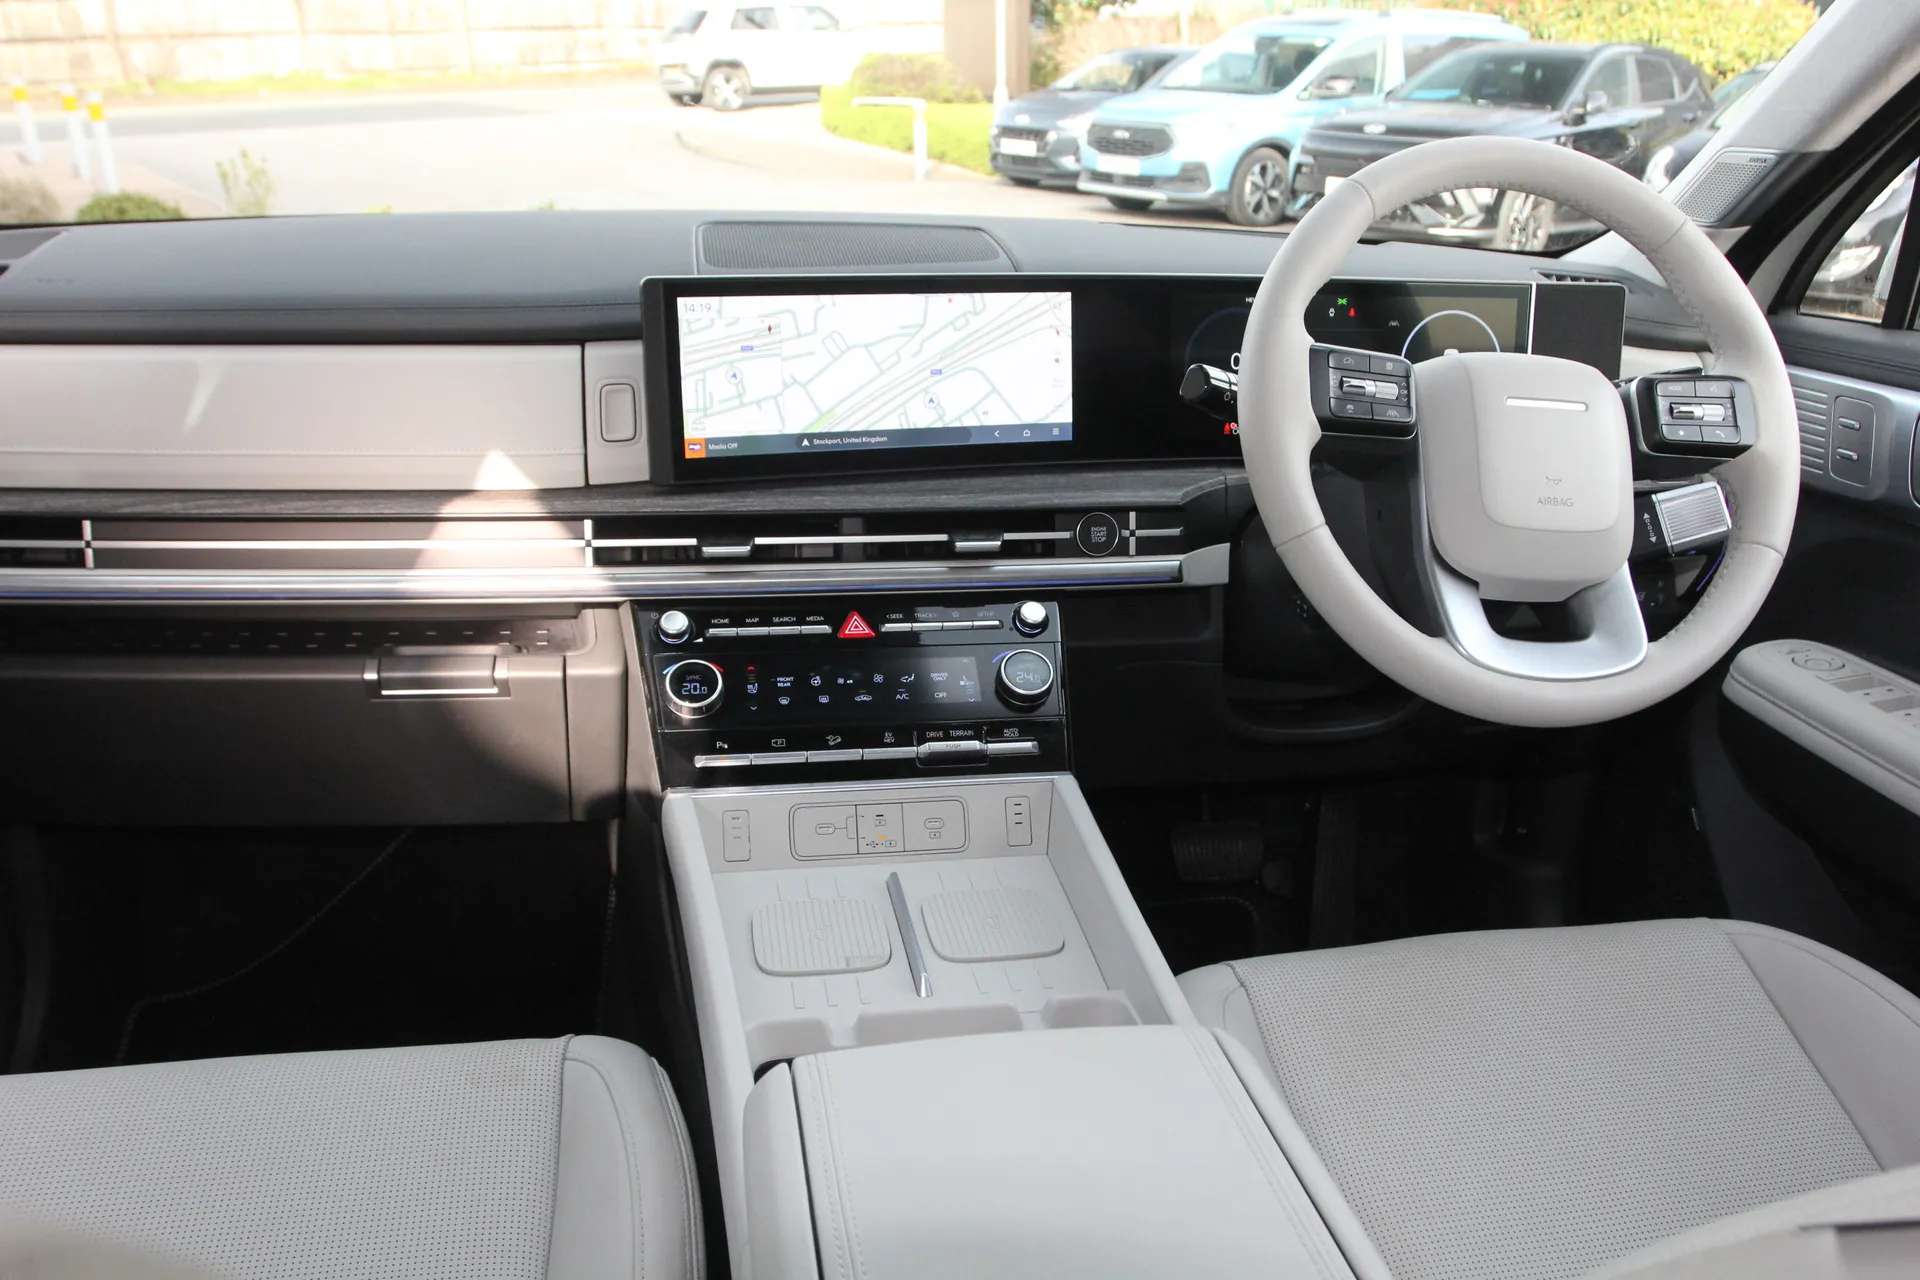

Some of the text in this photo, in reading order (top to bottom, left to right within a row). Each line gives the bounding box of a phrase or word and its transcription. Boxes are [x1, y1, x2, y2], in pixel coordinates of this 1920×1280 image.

[683, 302, 712, 313] 14:19
[813, 435, 888, 445] Stockport, United Kingdom
[1536, 497, 1575, 507] AIRBAG
[711, 617, 730, 625] HOME
[745, 616, 760, 624] MAP
[806, 614, 825, 622] MEDIA
[681, 683, 708, 695] 20.0
[895, 692, 910, 700] A/C
